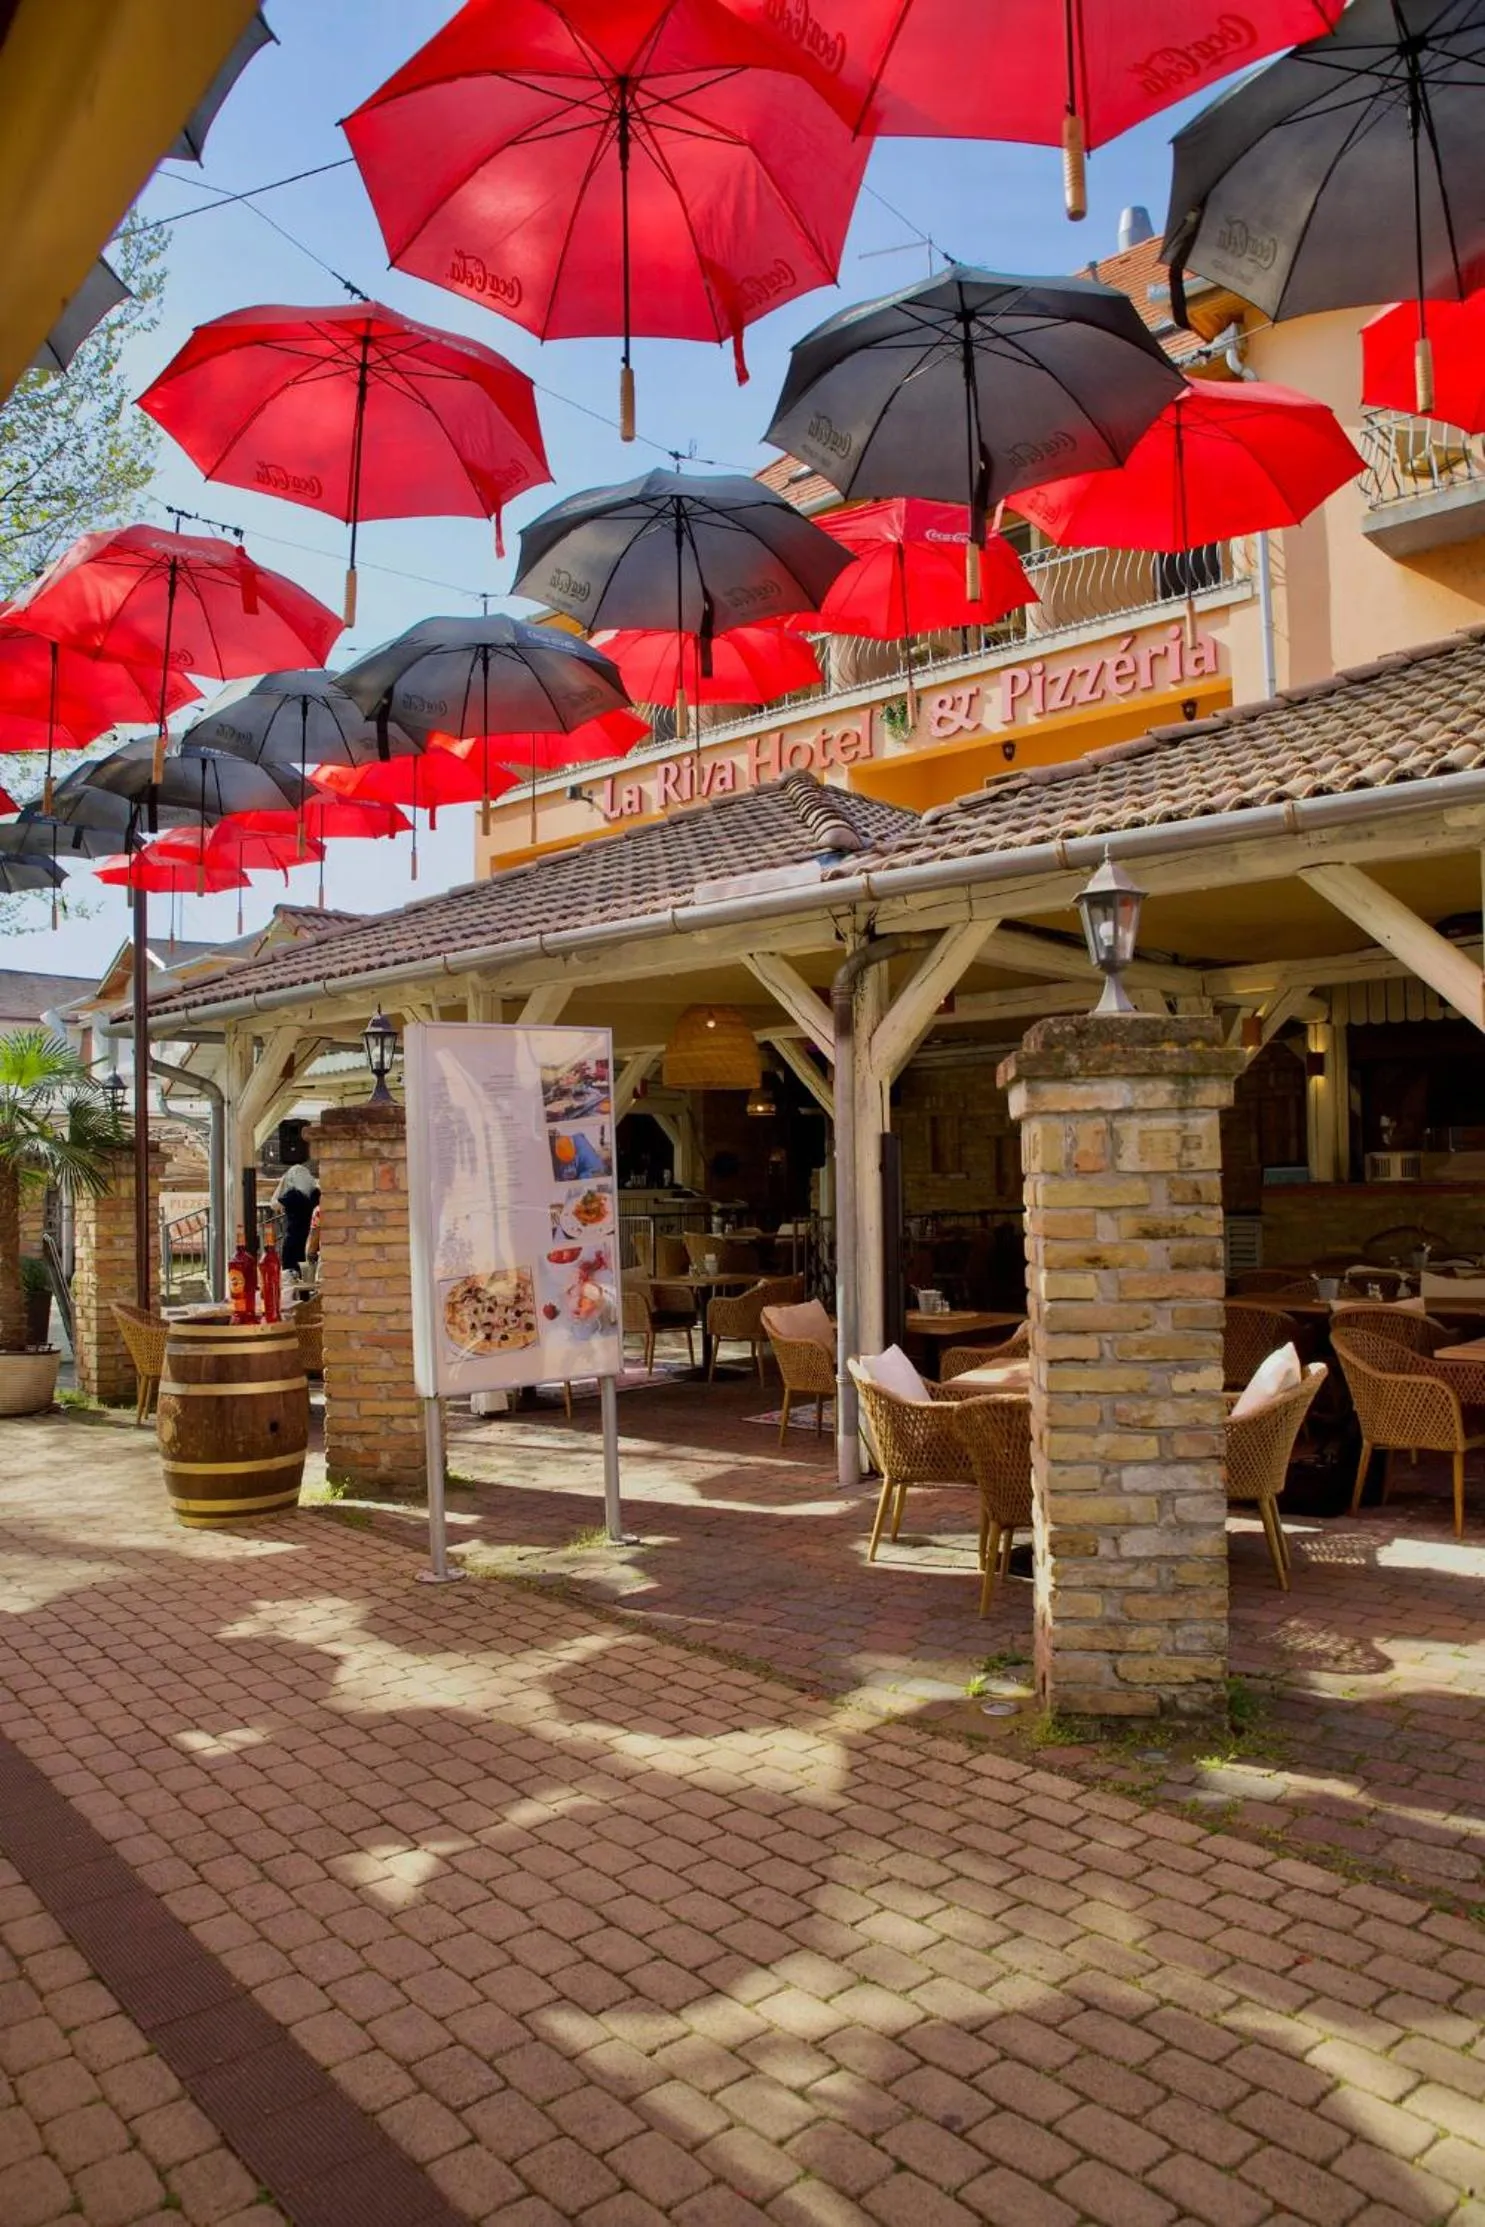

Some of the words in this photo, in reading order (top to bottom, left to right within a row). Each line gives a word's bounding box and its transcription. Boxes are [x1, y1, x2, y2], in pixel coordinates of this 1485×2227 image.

[603, 777, 642, 820] La
[656, 755, 736, 808] Riva
[746, 708, 874, 786] Hotel
[929, 685, 981, 738] &
[1000, 624, 1218, 723] Pizzéria
